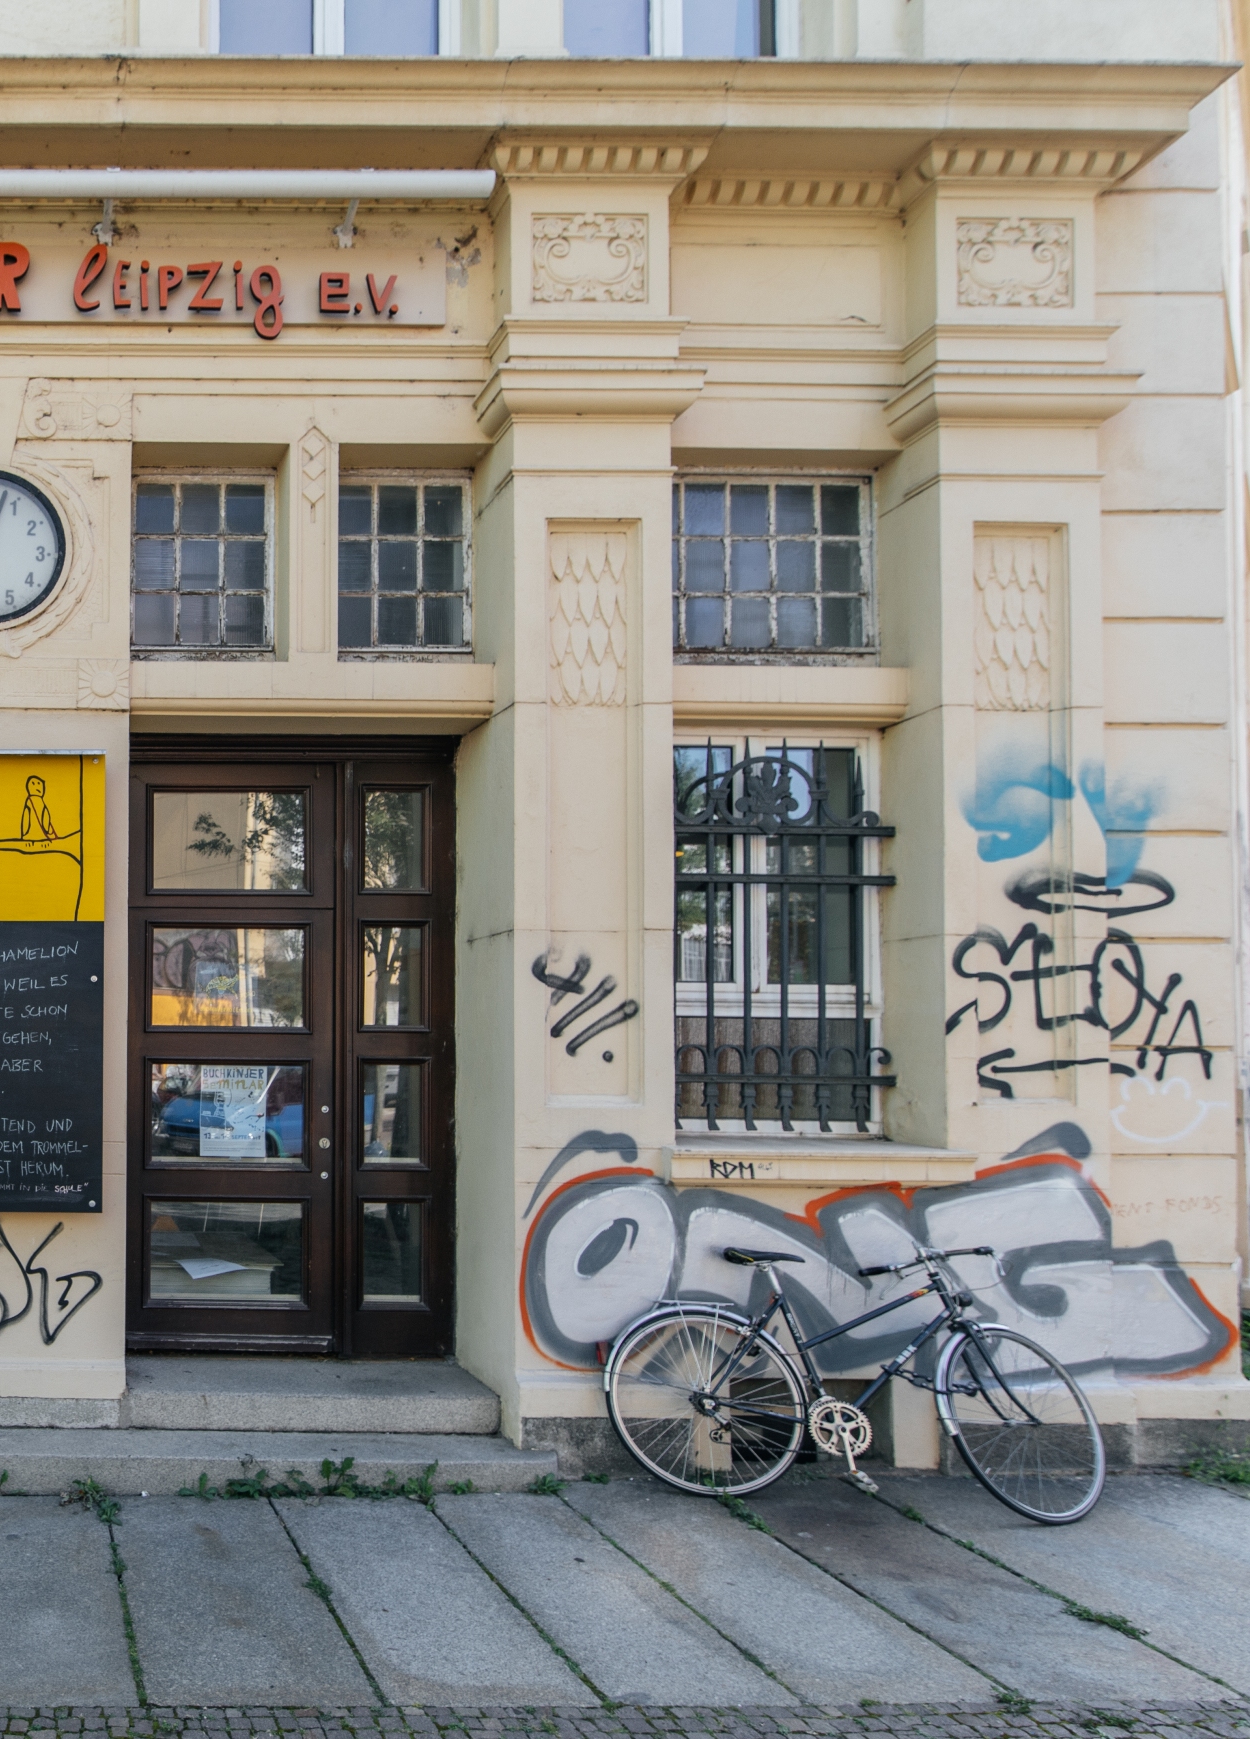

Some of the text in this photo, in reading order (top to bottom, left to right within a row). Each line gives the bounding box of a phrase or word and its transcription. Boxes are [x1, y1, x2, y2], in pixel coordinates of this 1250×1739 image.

[10, 500, 17, 516] 1
[27, 520, 37, 536] 2
[35, 546, 46, 562] 3
[24, 572, 35, 588] 4
[5, 590, 15, 606] 5
[3, 978, 46, 992] WEIL
[50, 974, 69, 987] ES
[20, 1004, 69, 1020] SCHON
[2, 1031, 52, 1046] GEHEN,
[0, 1059, 43, 1072] ABER
[46, 1118, 73, 1133] UND
[31, 1140, 89, 1155] TROMMEL-
[21, 1160, 69, 1177] HERUM.
[710, 1159, 755, 1179] RDM
